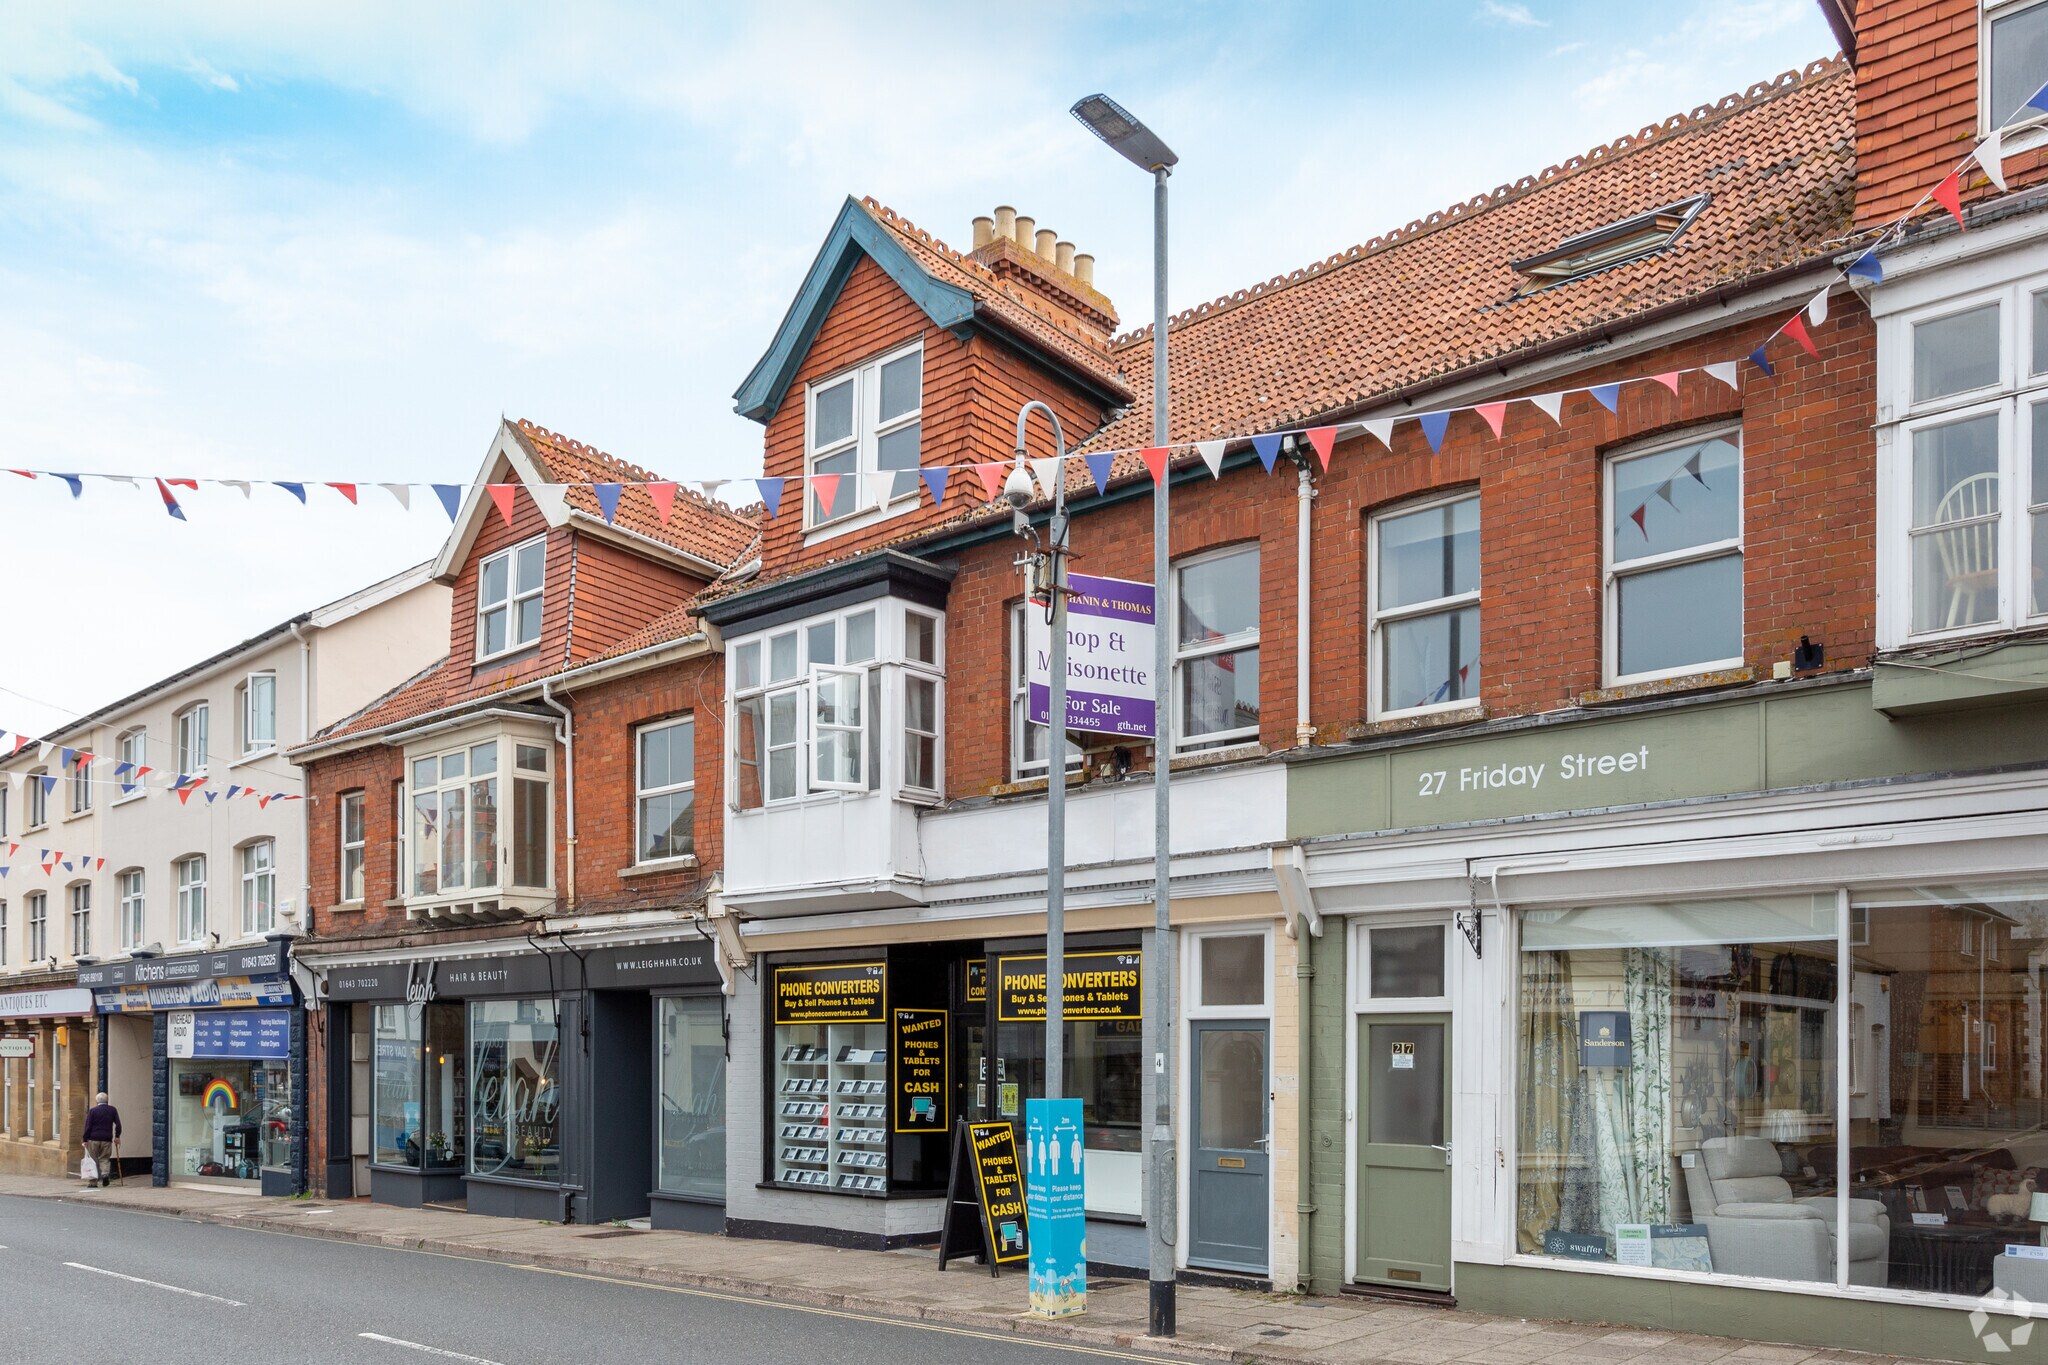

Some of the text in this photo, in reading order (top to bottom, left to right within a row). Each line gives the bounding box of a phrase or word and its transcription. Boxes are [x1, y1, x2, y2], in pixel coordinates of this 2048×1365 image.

[1067, 594, 1151, 614] HANIN & THOMAS
[1067, 631, 1125, 653] op &
[1038, 650, 1147, 685] Misonette
[1065, 696, 1121, 715] For Sale
[1068, 716, 1100, 727] 334455
[1117, 722, 1147, 732] gth.net
[1418, 745, 1649, 797] 27 Friday Street
[616, 957, 702, 970] WWW.LEIGHHAIR.CO.UK
[135, 964, 164, 981] Kitchens
[450, 970, 508, 983] HAIR & BEAUTY
[339, 978, 378, 989] 01643 702220
[1005, 974, 1046, 991] PHONE
[1063, 971, 1137, 989] ONVERTERS
[149, 983, 220, 1005] MINEHEAD RADIO
[406, 958, 435, 1022] leigh
[780, 979, 880, 997] PHONE CONVERTERS
[35, 994, 49, 1009] ETC
[785, 1000, 797, 1009] Buy
[805, 999, 817, 1007] Sell
[818, 999, 841, 1007] Phones
[850, 997, 875, 1005] Tablets
[1012, 995, 1026, 1005] Buy
[1029, 995, 1035, 1003] &
[1037, 994, 1047, 1003] Se
[1087, 993, 1094, 1001] &
[1096, 992, 1129, 1001] Tablets
[790, 1009, 869, 1019] www.phoneconverters.co.uk
[1018, 1006, 1122, 1016] www.phonverters.co.uk
[174, 1027, 187, 1037] RADIO
[902, 1019, 942, 1034] WANTED
[905, 1041, 939, 1049] PHONES
[1394, 1043, 1413, 1054] 27
[1584, 1039, 1625, 1048] Sanderson
[919, 1049, 925, 1057] &
[903, 1057, 940, 1065] TABLETS
[1156, 1059, 1162, 1068] 4
[904, 1082, 940, 1093] CASH
[516, 1125, 554, 1139] BEAUTY
[977, 1130, 1011, 1150] WANTED
[983, 1156, 1013, 1167] PHONES
[997, 1166, 1003, 1174] &
[985, 1174, 1017, 1185] TABLETS
[996, 1188, 1011, 1197] FOR
[1050, 1193, 1083, 1203] your distance
[991, 1202, 1022, 1217] CASH
[1570, 1243, 1603, 1255] swaffer
